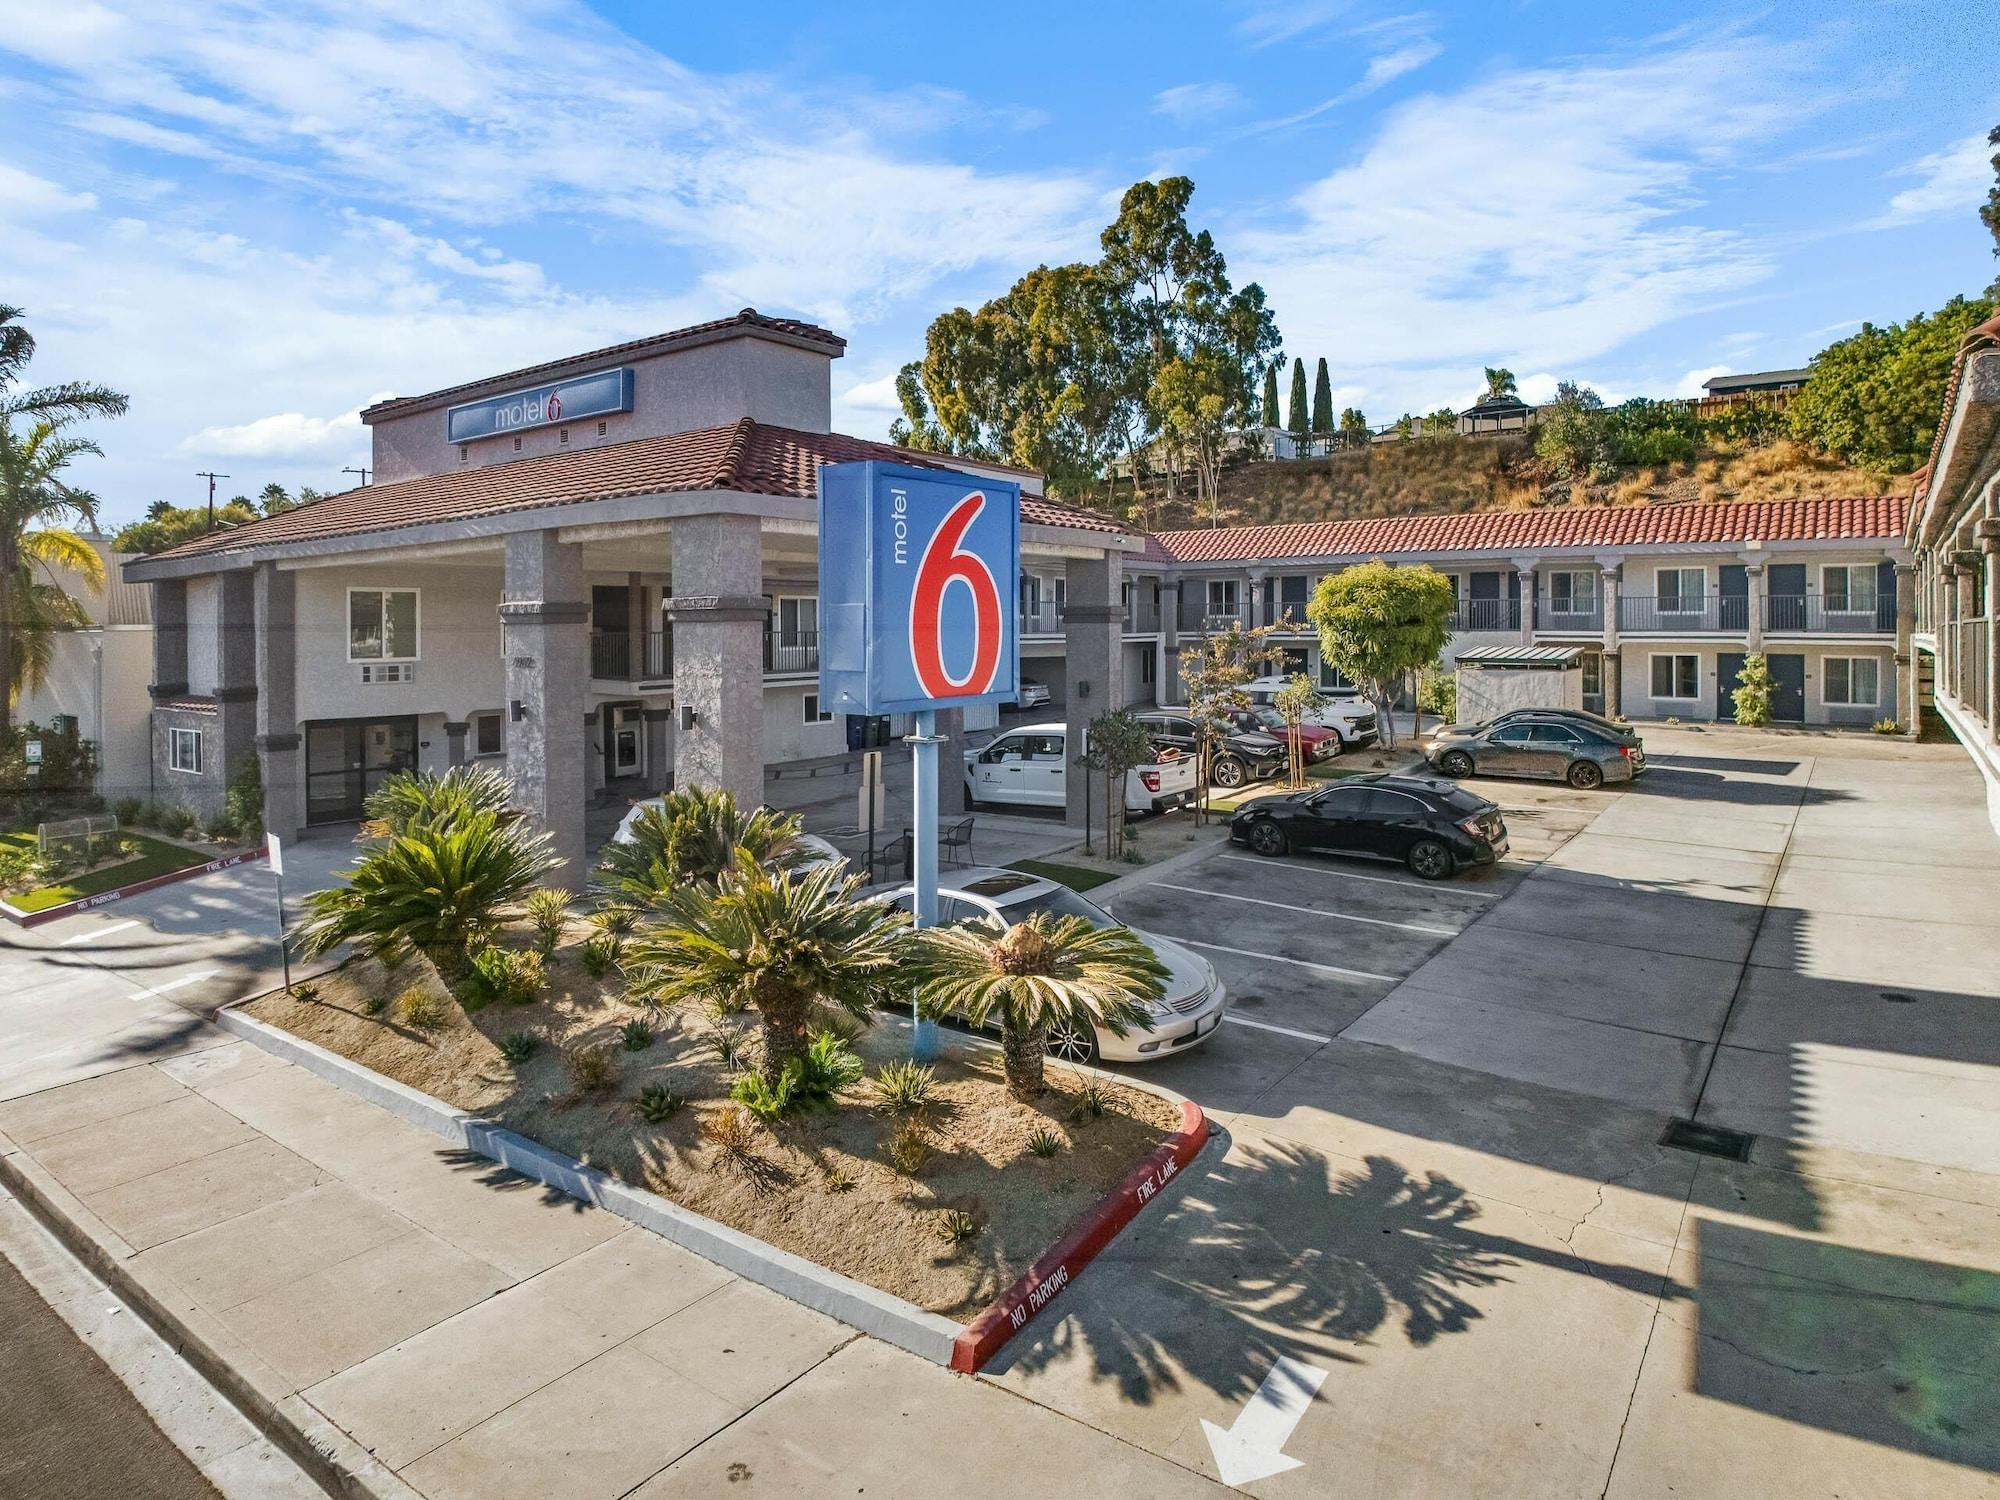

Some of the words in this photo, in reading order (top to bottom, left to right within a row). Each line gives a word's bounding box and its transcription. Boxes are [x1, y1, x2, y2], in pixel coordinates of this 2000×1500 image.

[495, 393, 543, 428] motel
[546, 385, 562, 422] 6
[890, 488, 907, 564] motel
[908, 490, 1003, 699] 6
[206, 861, 222, 872] FIRE
[224, 855, 242, 867] LANE
[77, 901, 88, 910] NO
[90, 891, 121, 906] PARKING
[1137, 1176, 1157, 1204] FIRE
[1156, 1155, 1178, 1184] LANE
[1010, 1303, 1027, 1329] NO
[1029, 1264, 1068, 1312] PARKING
